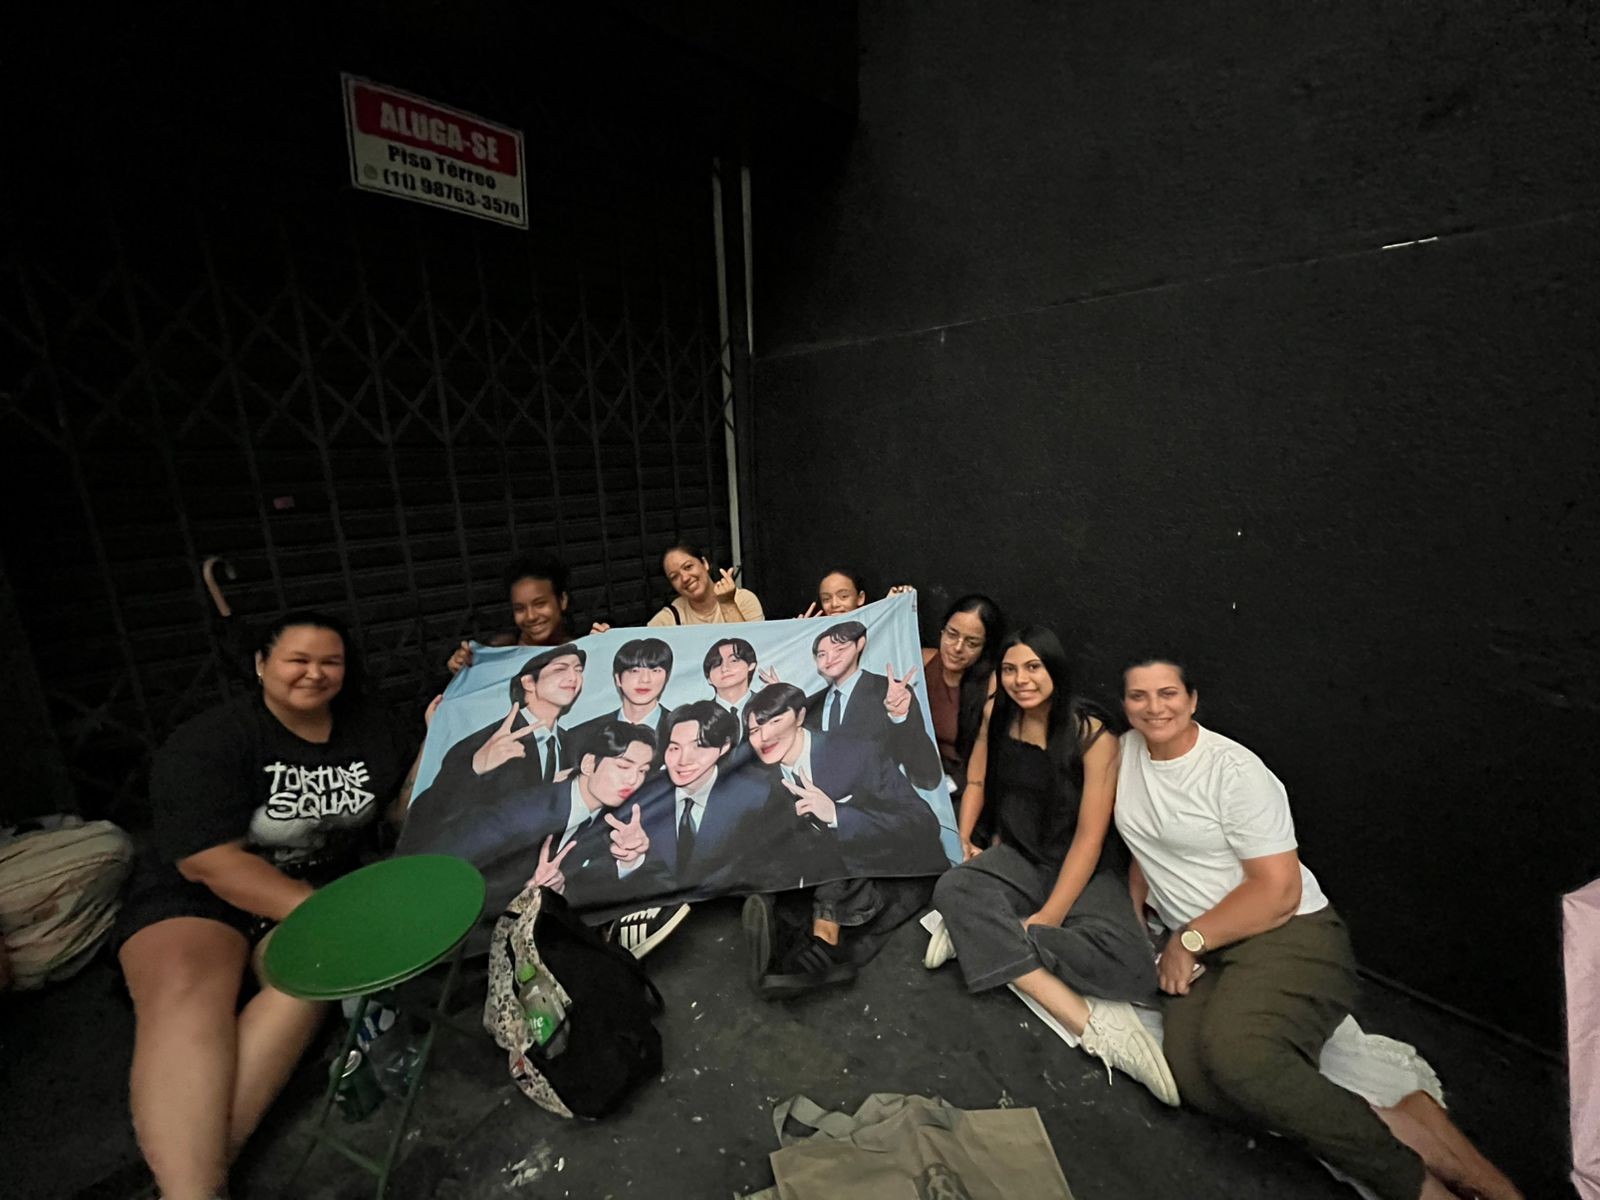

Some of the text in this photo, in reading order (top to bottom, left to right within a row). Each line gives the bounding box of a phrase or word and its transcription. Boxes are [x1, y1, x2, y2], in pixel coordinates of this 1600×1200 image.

[380, 102, 500, 164] ALUGA-SE
[388, 145, 431, 171] Piso
[384, 169, 520, 218] (11) 98763-3570
[264, 761, 370, 794] TORTURE
[267, 787, 376, 819] SQUAD
